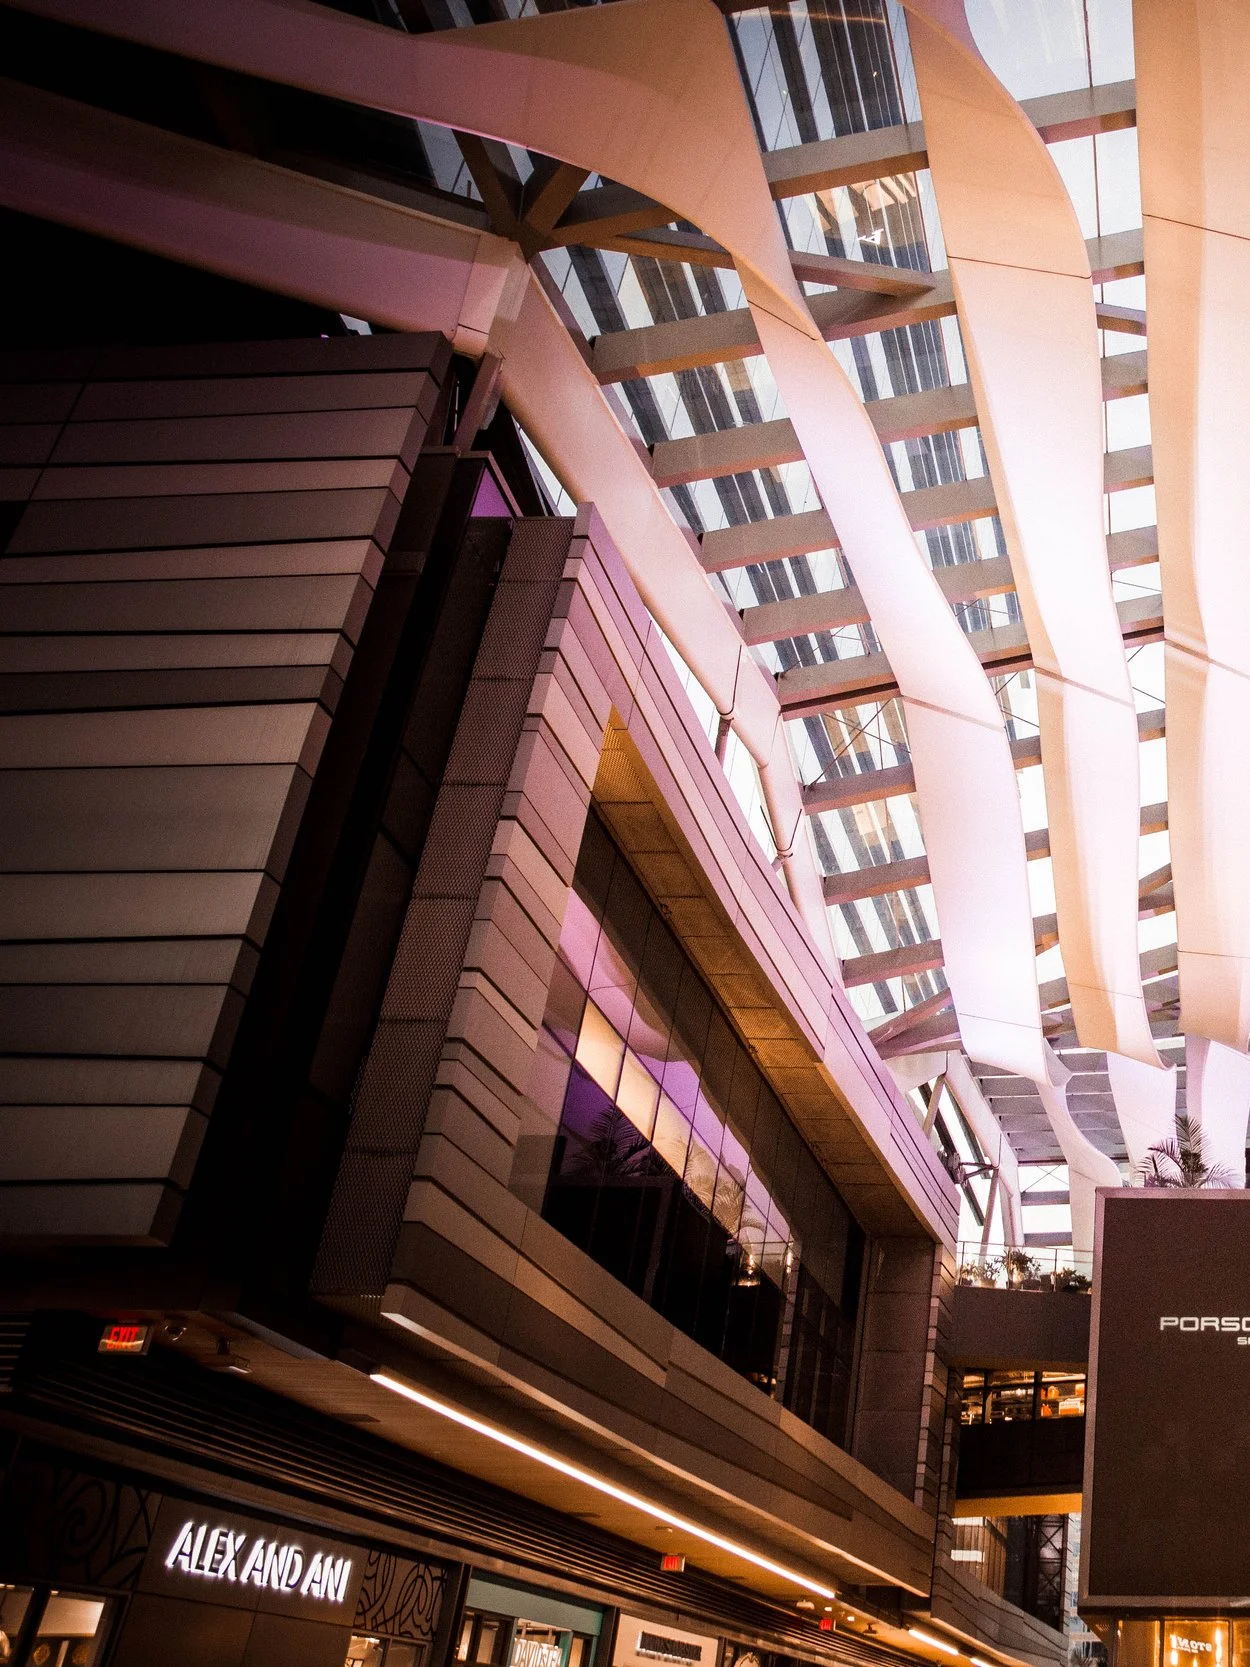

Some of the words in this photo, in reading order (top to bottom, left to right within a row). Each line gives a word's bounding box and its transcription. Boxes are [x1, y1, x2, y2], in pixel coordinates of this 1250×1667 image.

[107, 1326, 140, 1350] EXIT
[165, 1520, 247, 1582] ALEX
[240, 1539, 305, 1592] AND
[301, 1552, 352, 1602] ANI
